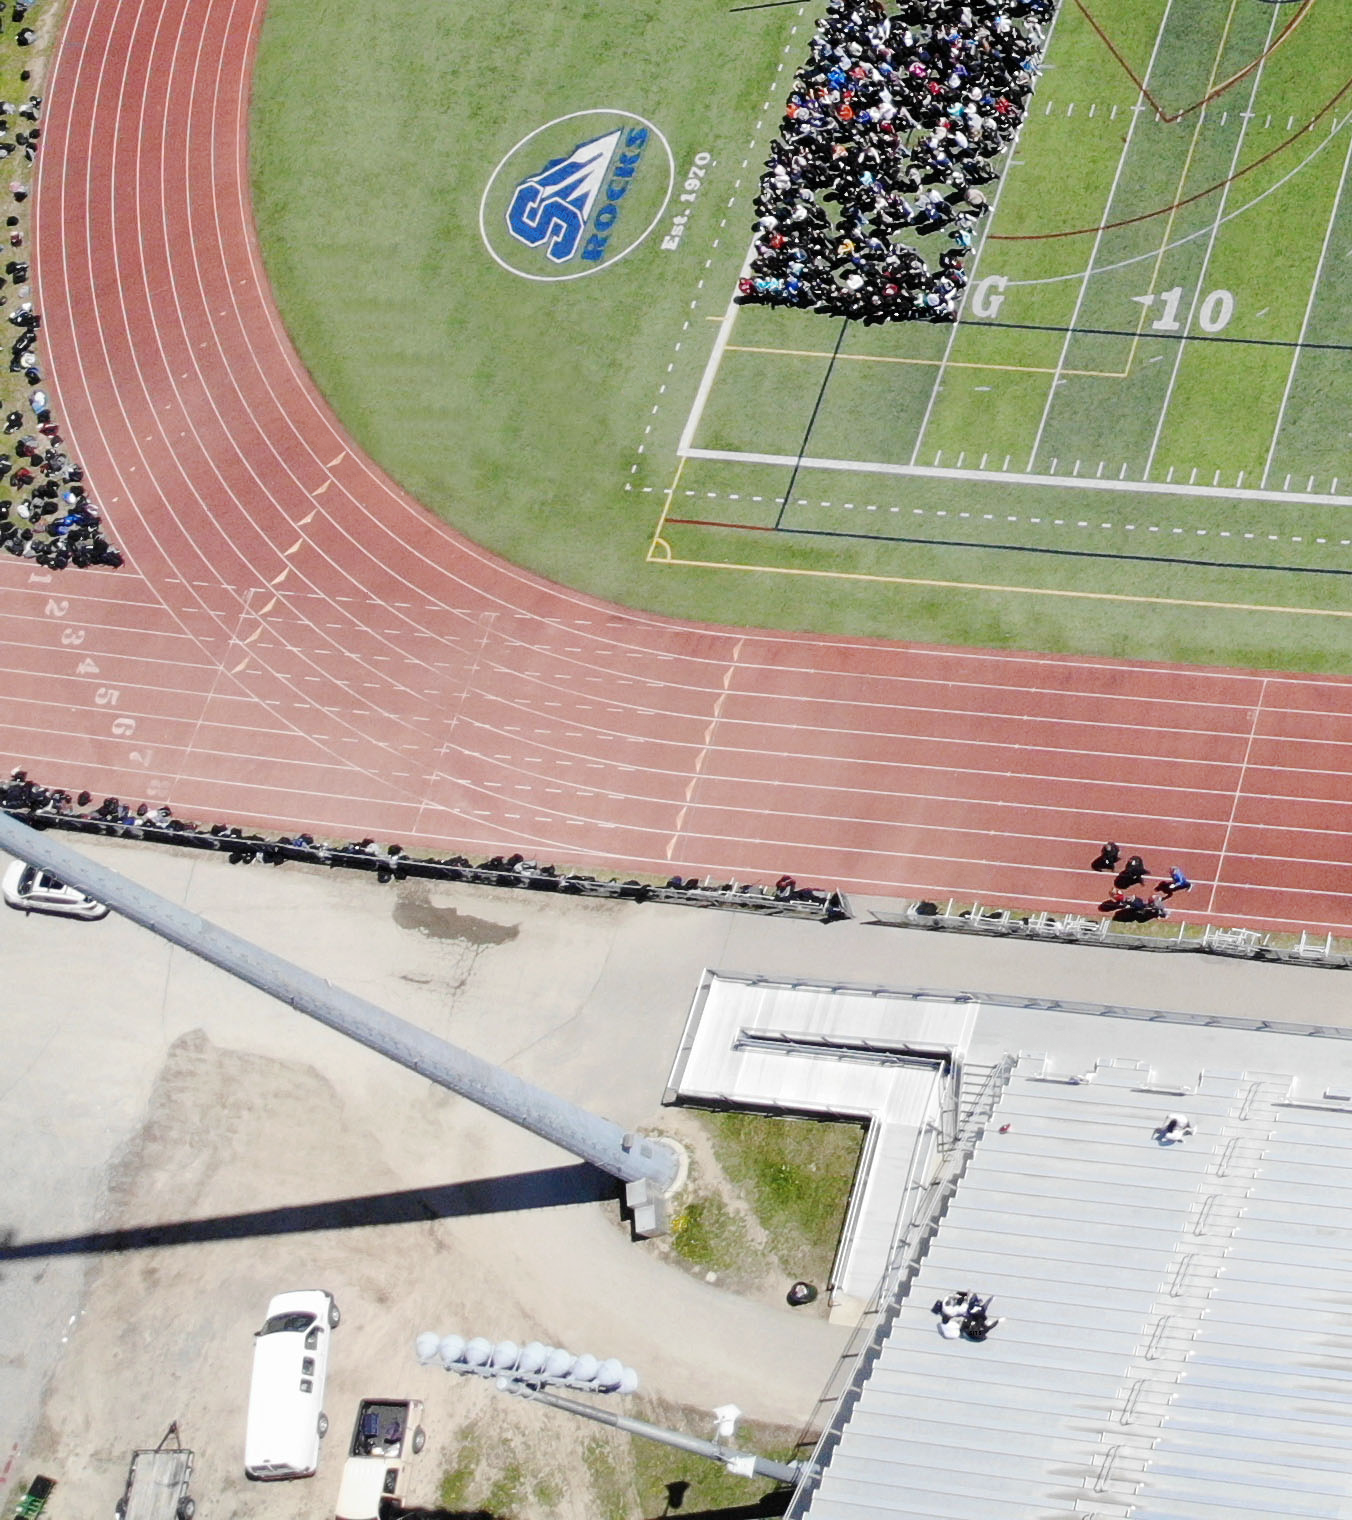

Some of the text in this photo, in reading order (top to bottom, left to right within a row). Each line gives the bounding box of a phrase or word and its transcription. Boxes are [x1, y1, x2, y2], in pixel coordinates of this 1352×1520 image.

[581, 127, 649, 262] ROCKS
[660, 151, 712, 251] Est. 1970
[970, 275, 1005, 319] G
[1151, 285, 1235, 334] 10
[28, 572, 53, 584] 1
[44, 598, 70, 617] 2
[61, 628, 86, 645] 3
[76, 657, 100, 675] 4
[94, 687, 121, 706] 5
[111, 717, 136, 736] 6
